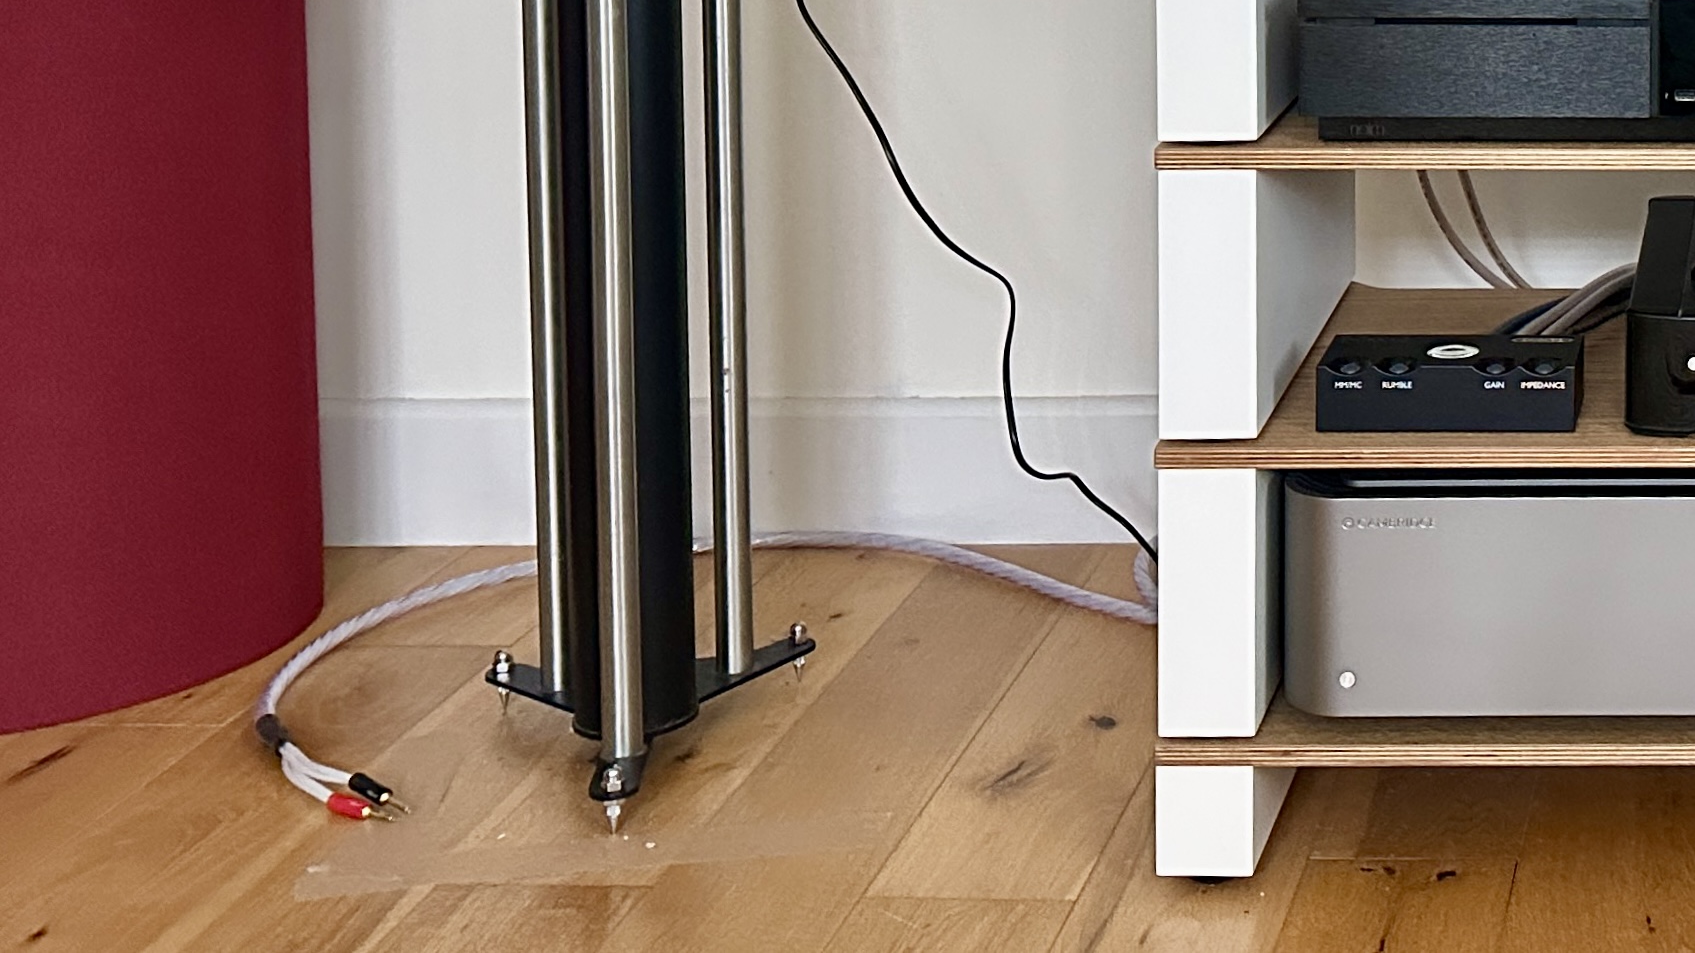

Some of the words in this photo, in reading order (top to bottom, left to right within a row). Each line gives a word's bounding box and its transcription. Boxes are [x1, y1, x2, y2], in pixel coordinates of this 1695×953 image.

[1381, 381, 1413, 390] RUMBLE
[1483, 381, 1505, 390] GAIN
[1520, 381, 1566, 390] IMPEDANCE
[1358, 517, 1435, 529] CAMBRIDGE
